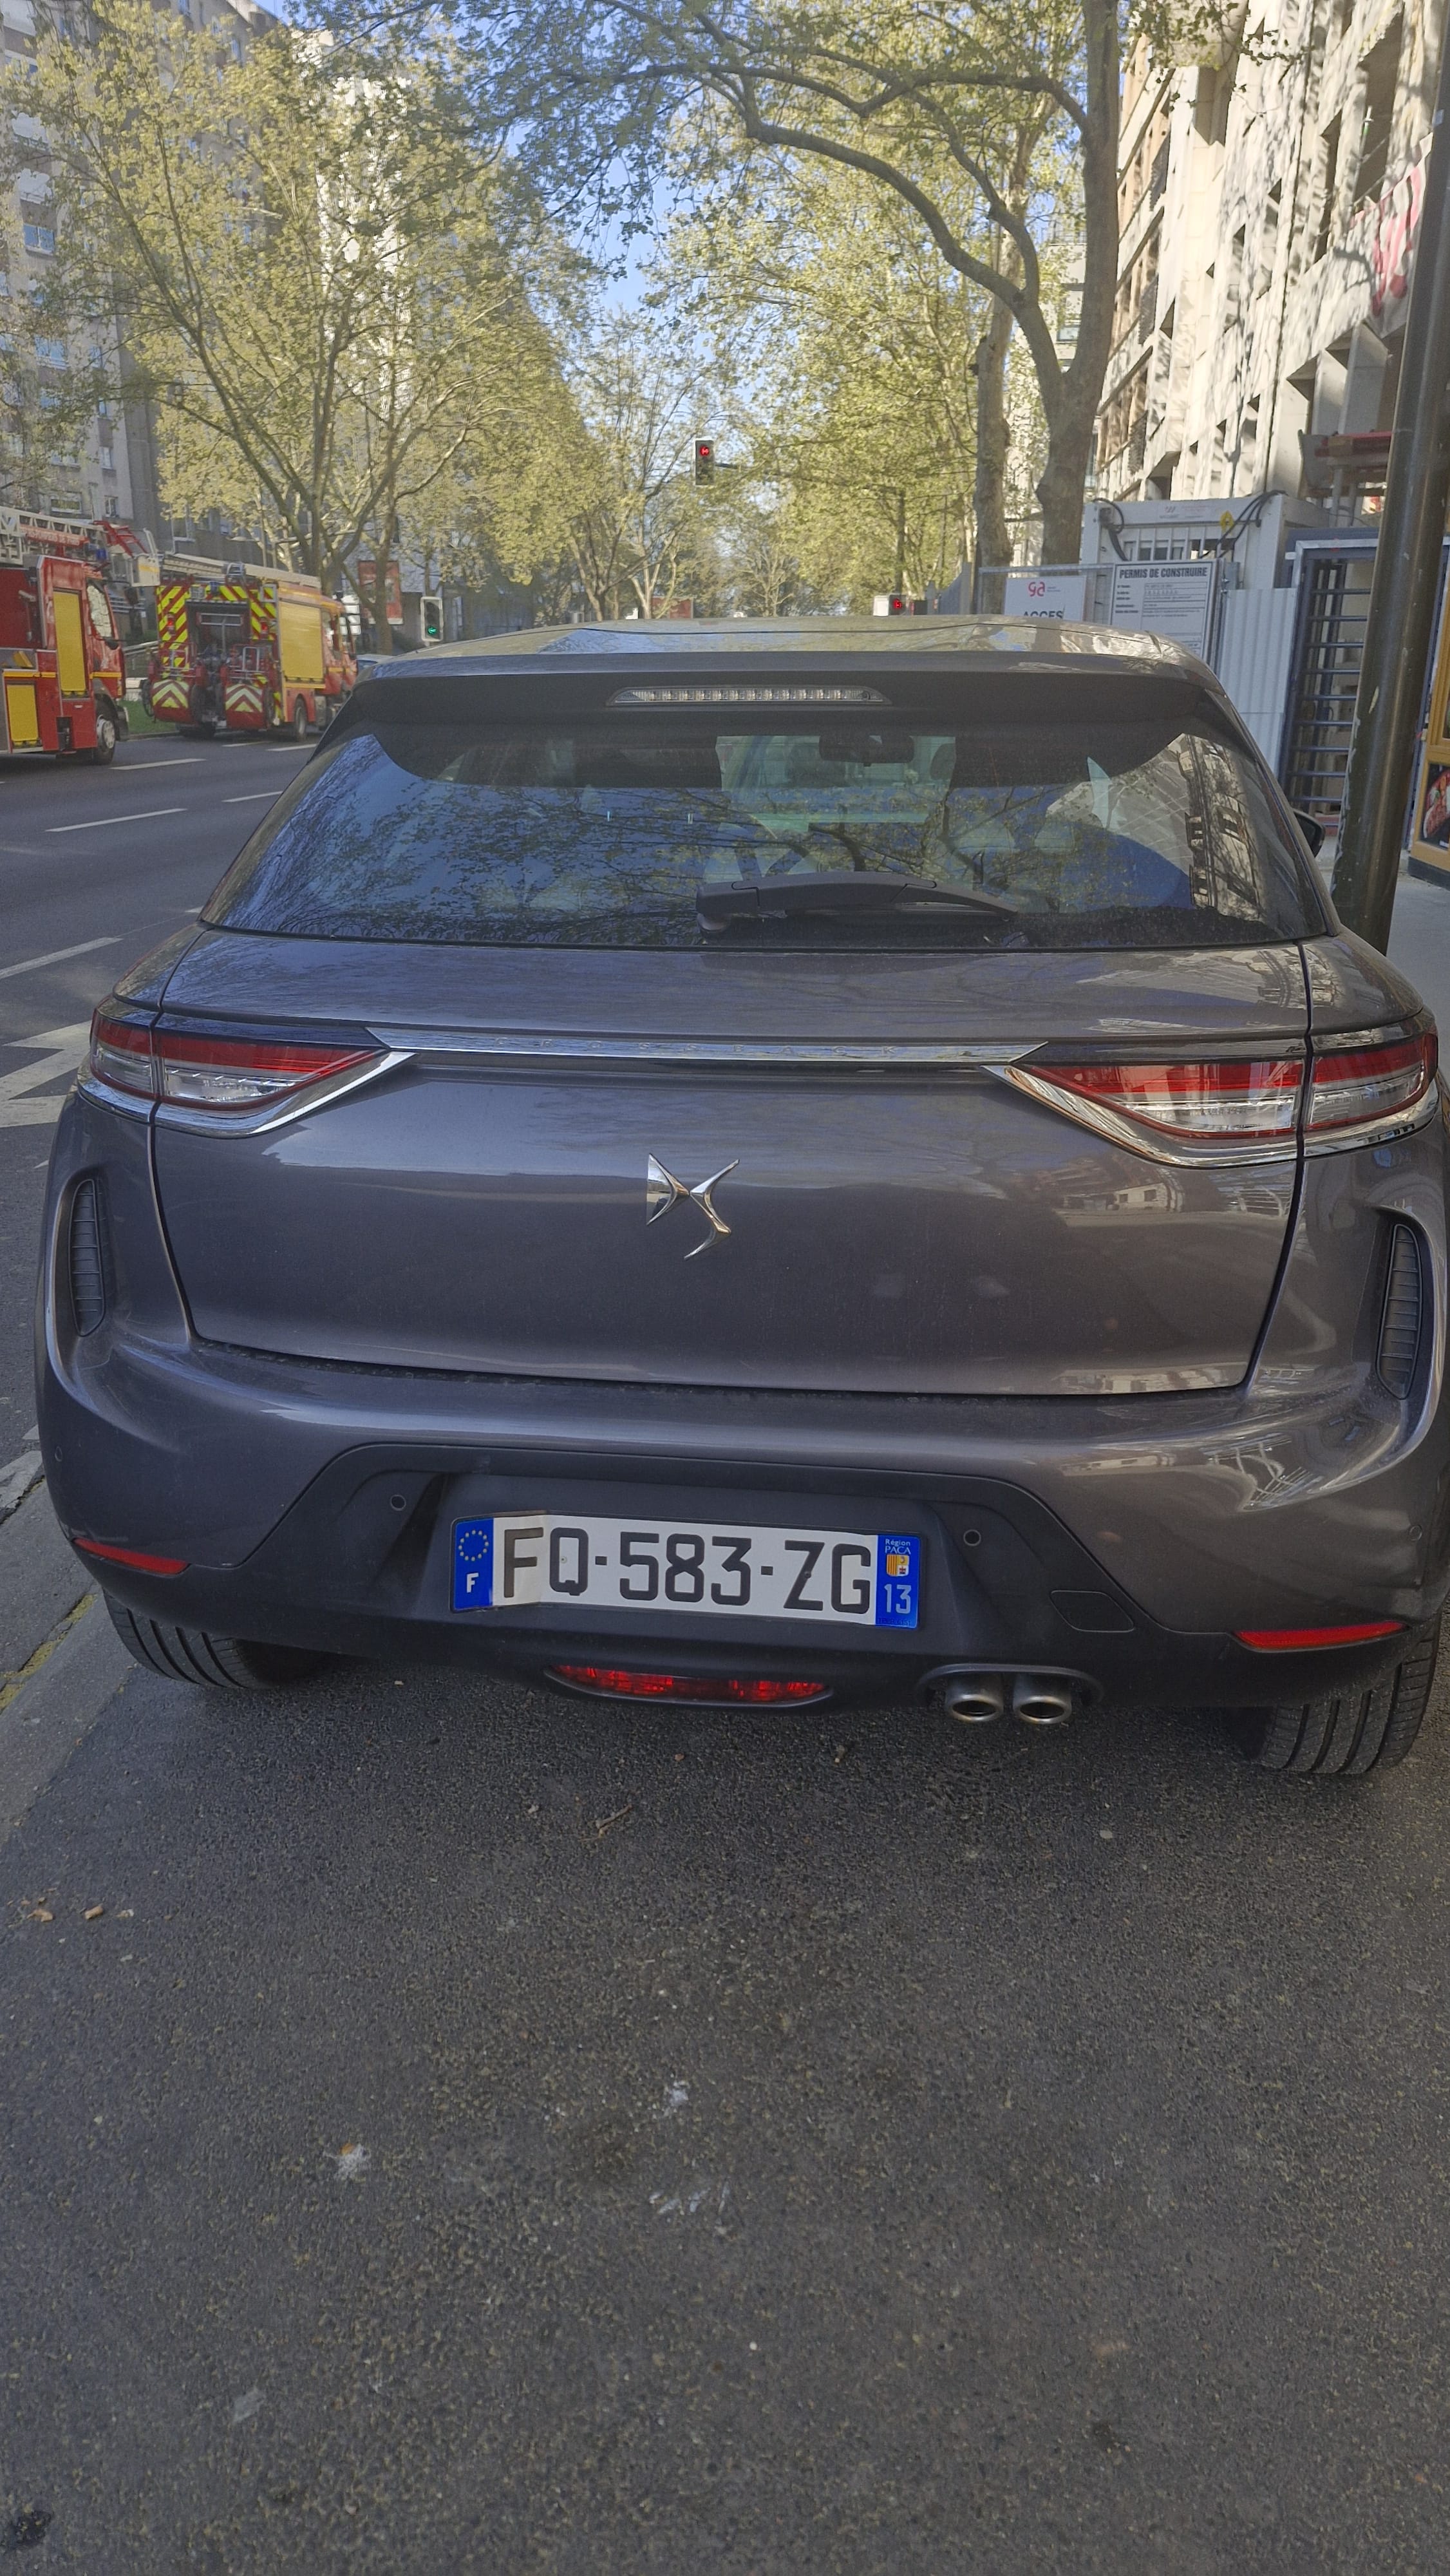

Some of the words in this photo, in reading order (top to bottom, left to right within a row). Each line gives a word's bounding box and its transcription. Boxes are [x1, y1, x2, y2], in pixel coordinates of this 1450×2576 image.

[1119, 568, 1148, 579] PERMIS
[1149, 567, 1160, 578] DE
[1160, 567, 1208, 578] CONSTRUIRE
[885, 1539, 911, 1547] Région
[885, 1546, 912, 1555] PACA
[504, 1527, 872, 1615] FQ-583-ZG
[466, 1571, 480, 1594] F
[883, 1584, 912, 1615] 13
